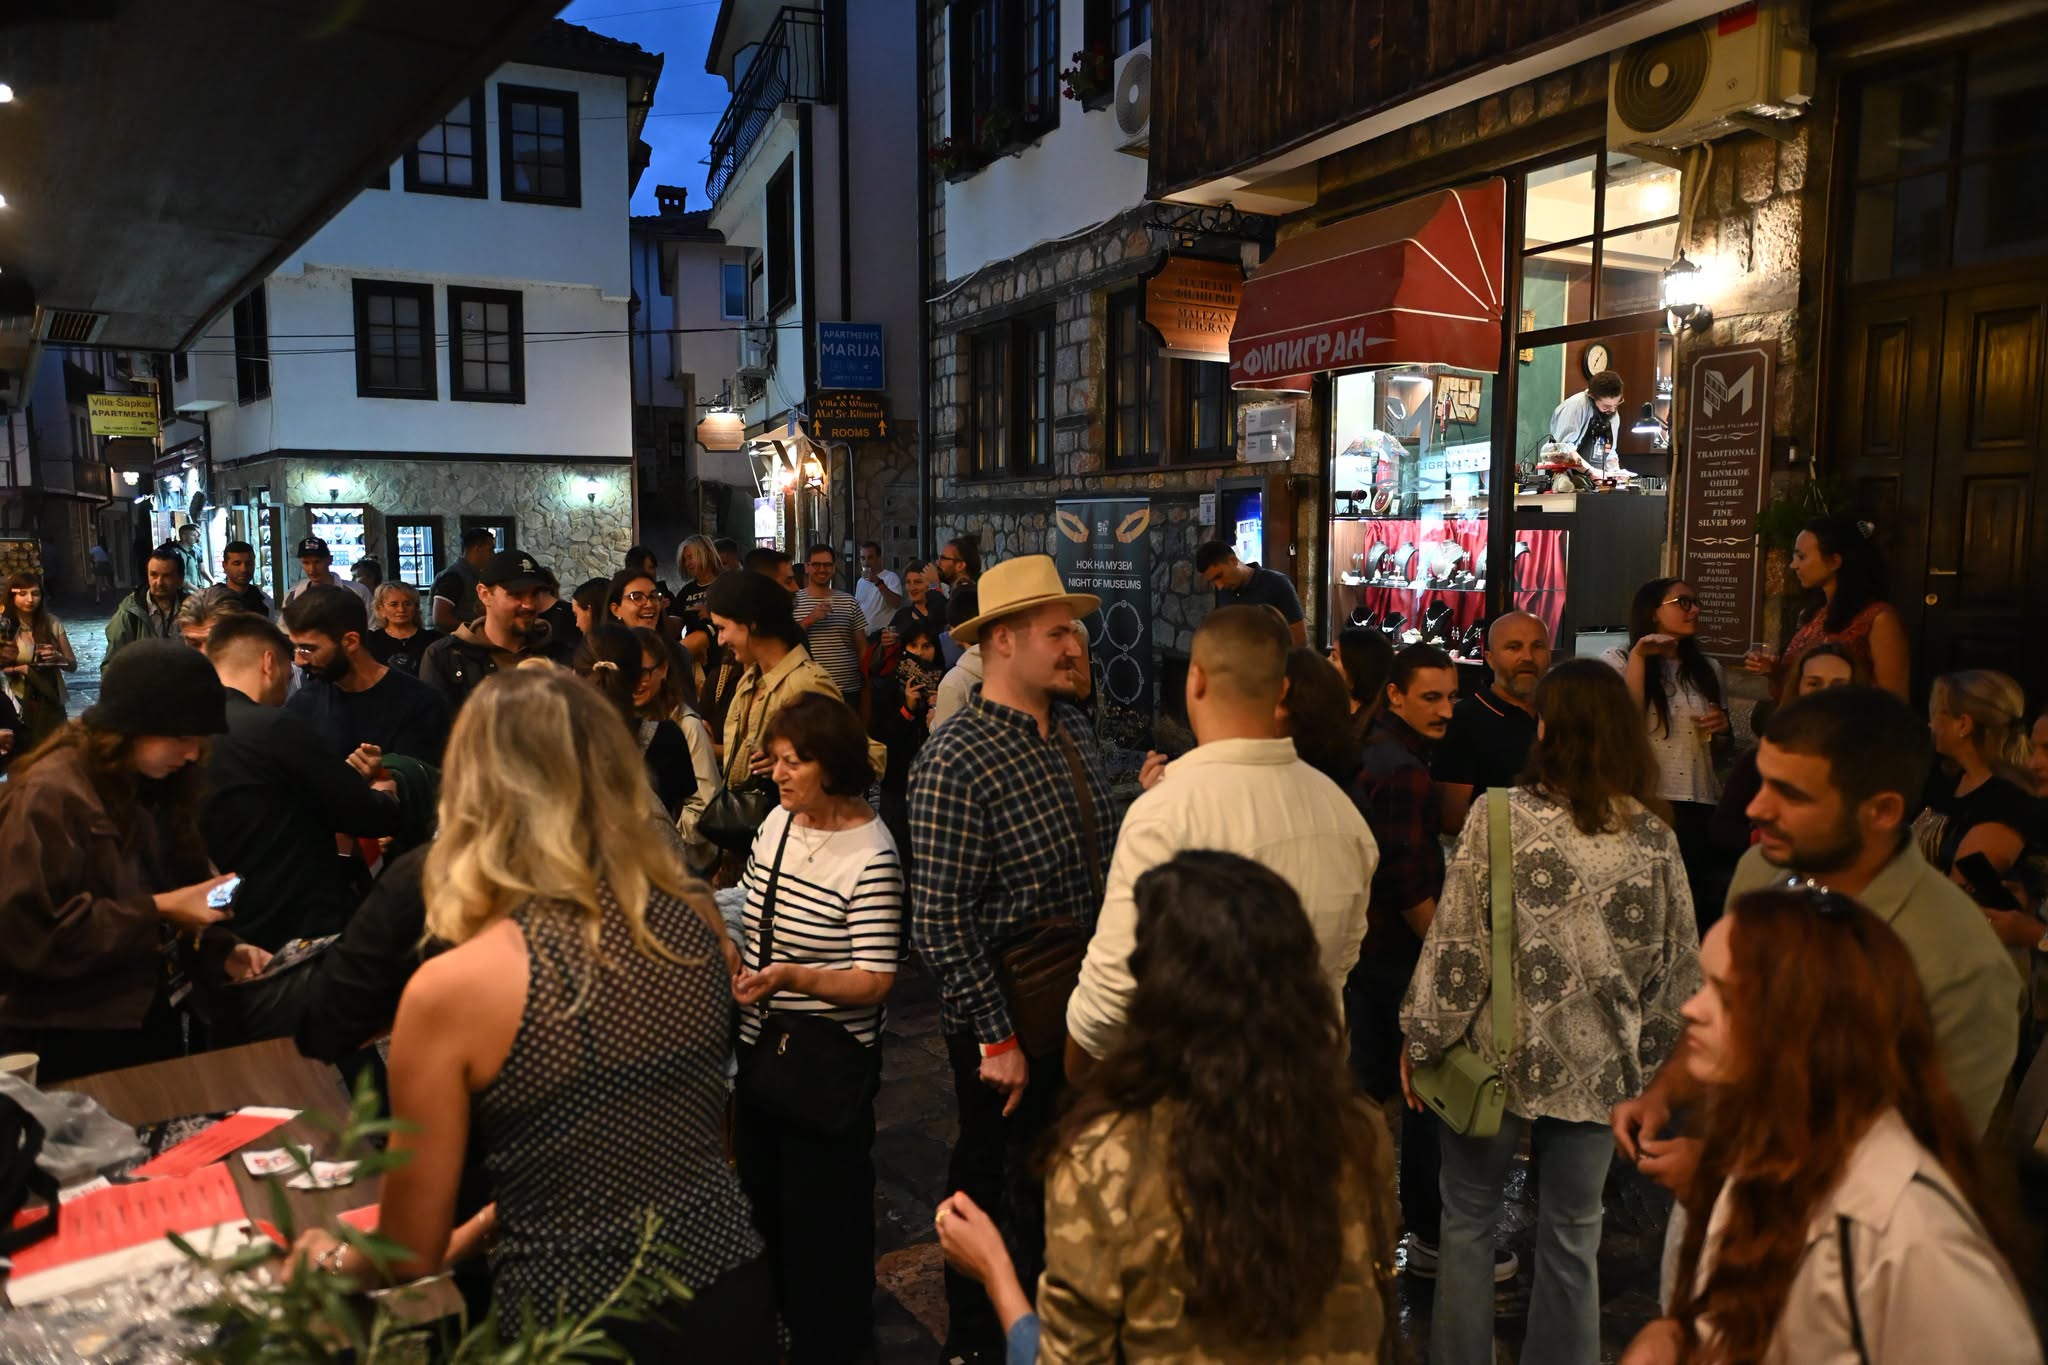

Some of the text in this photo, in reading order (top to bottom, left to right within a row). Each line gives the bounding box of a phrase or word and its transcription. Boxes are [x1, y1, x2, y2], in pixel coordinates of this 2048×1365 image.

[1177, 307, 1231, 322] MALEZAN
[1177, 319, 1230, 333] FILIGRAN
[823, 330, 880, 340] APARTMENTS
[822, 343, 881, 357] MARIJA
[1242, 326, 1364, 376] ФИЛИГРАН
[91, 397, 113, 407] Villa
[91, 409, 155, 418] APARTMENTS
[831, 428, 870, 438] ROOMS
[1696, 448, 1757, 459] TRADITIONAL
[1700, 468, 1750, 478] HADNMADE
[1709, 479, 1739, 487] OHRID
[1703, 488, 1744, 497] FILIGREE
[1712, 509, 1733, 517] FINE
[1697, 519, 1728, 527] SILVER
[1688, 552, 1751, 560] ТРАДИЦИОНАЛНО
[1076, 558, 1133, 571] НОЌ НА МУЗЕИ
[1068, 577, 1142, 590] NIGHT OF MUSEUMS
[1700, 600, 1736, 608] ИЛИГРАН
